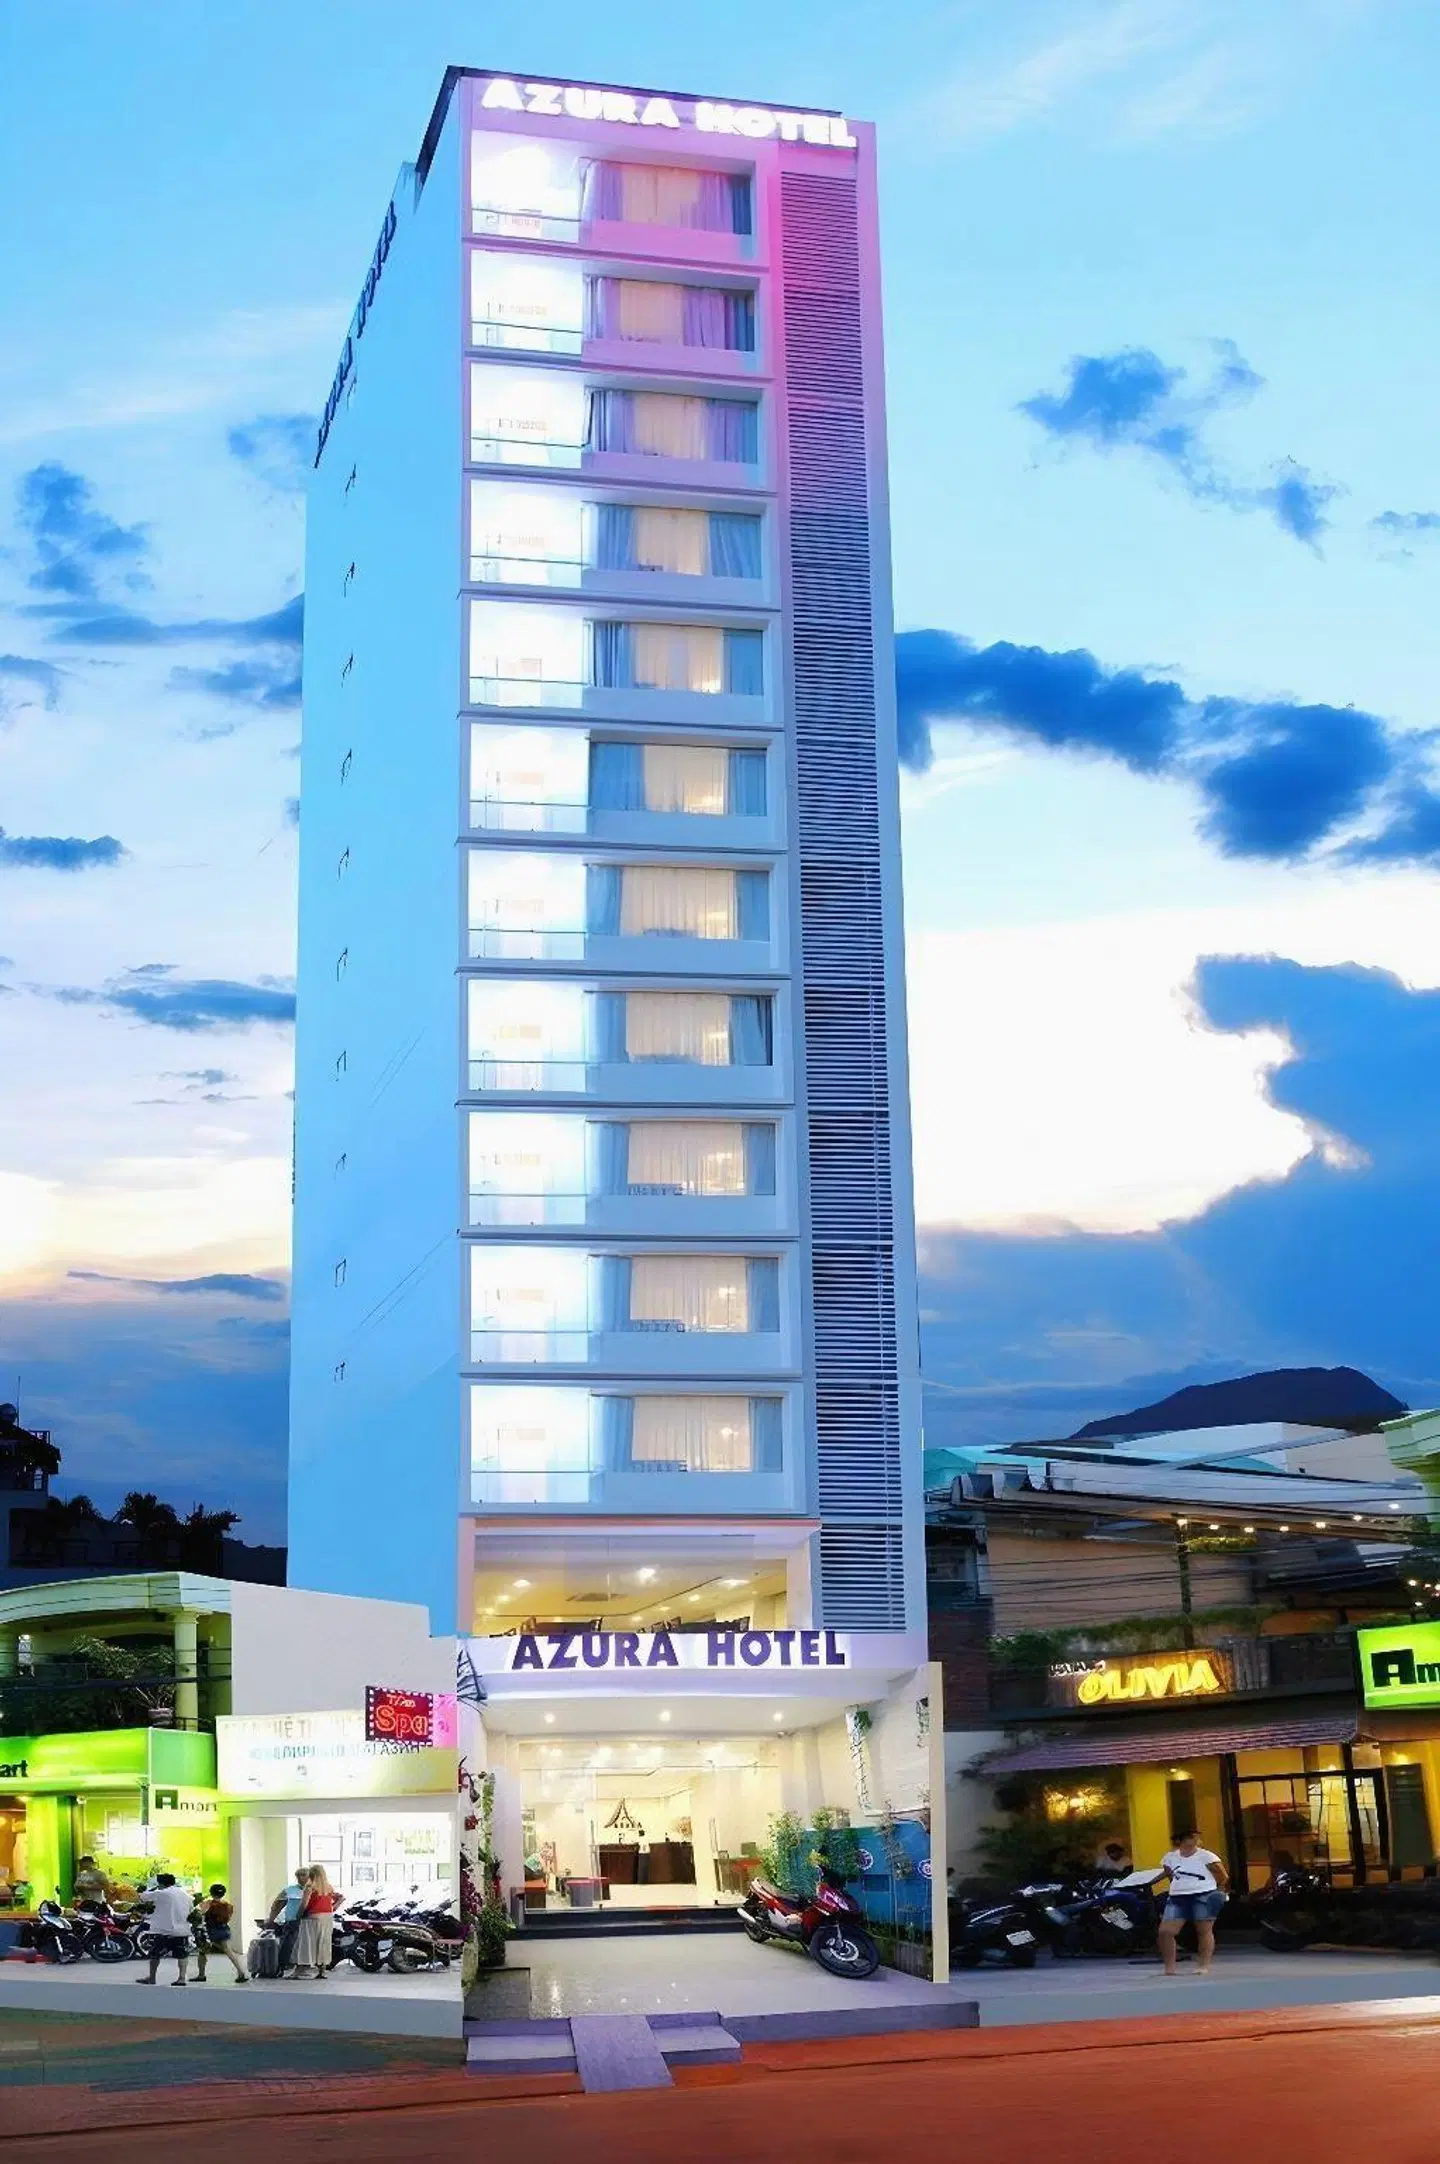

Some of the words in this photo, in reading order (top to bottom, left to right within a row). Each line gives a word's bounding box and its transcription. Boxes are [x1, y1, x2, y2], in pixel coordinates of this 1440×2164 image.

[481, 78, 680, 128] AZURA
[695, 101, 858, 148] HOTEL
[511, 1630, 680, 1670] AZURA
[706, 1629, 846, 1667] HOTEL
[1078, 1660, 1220, 1704] OLIVIA
[375, 1704, 428, 1738] Spa
